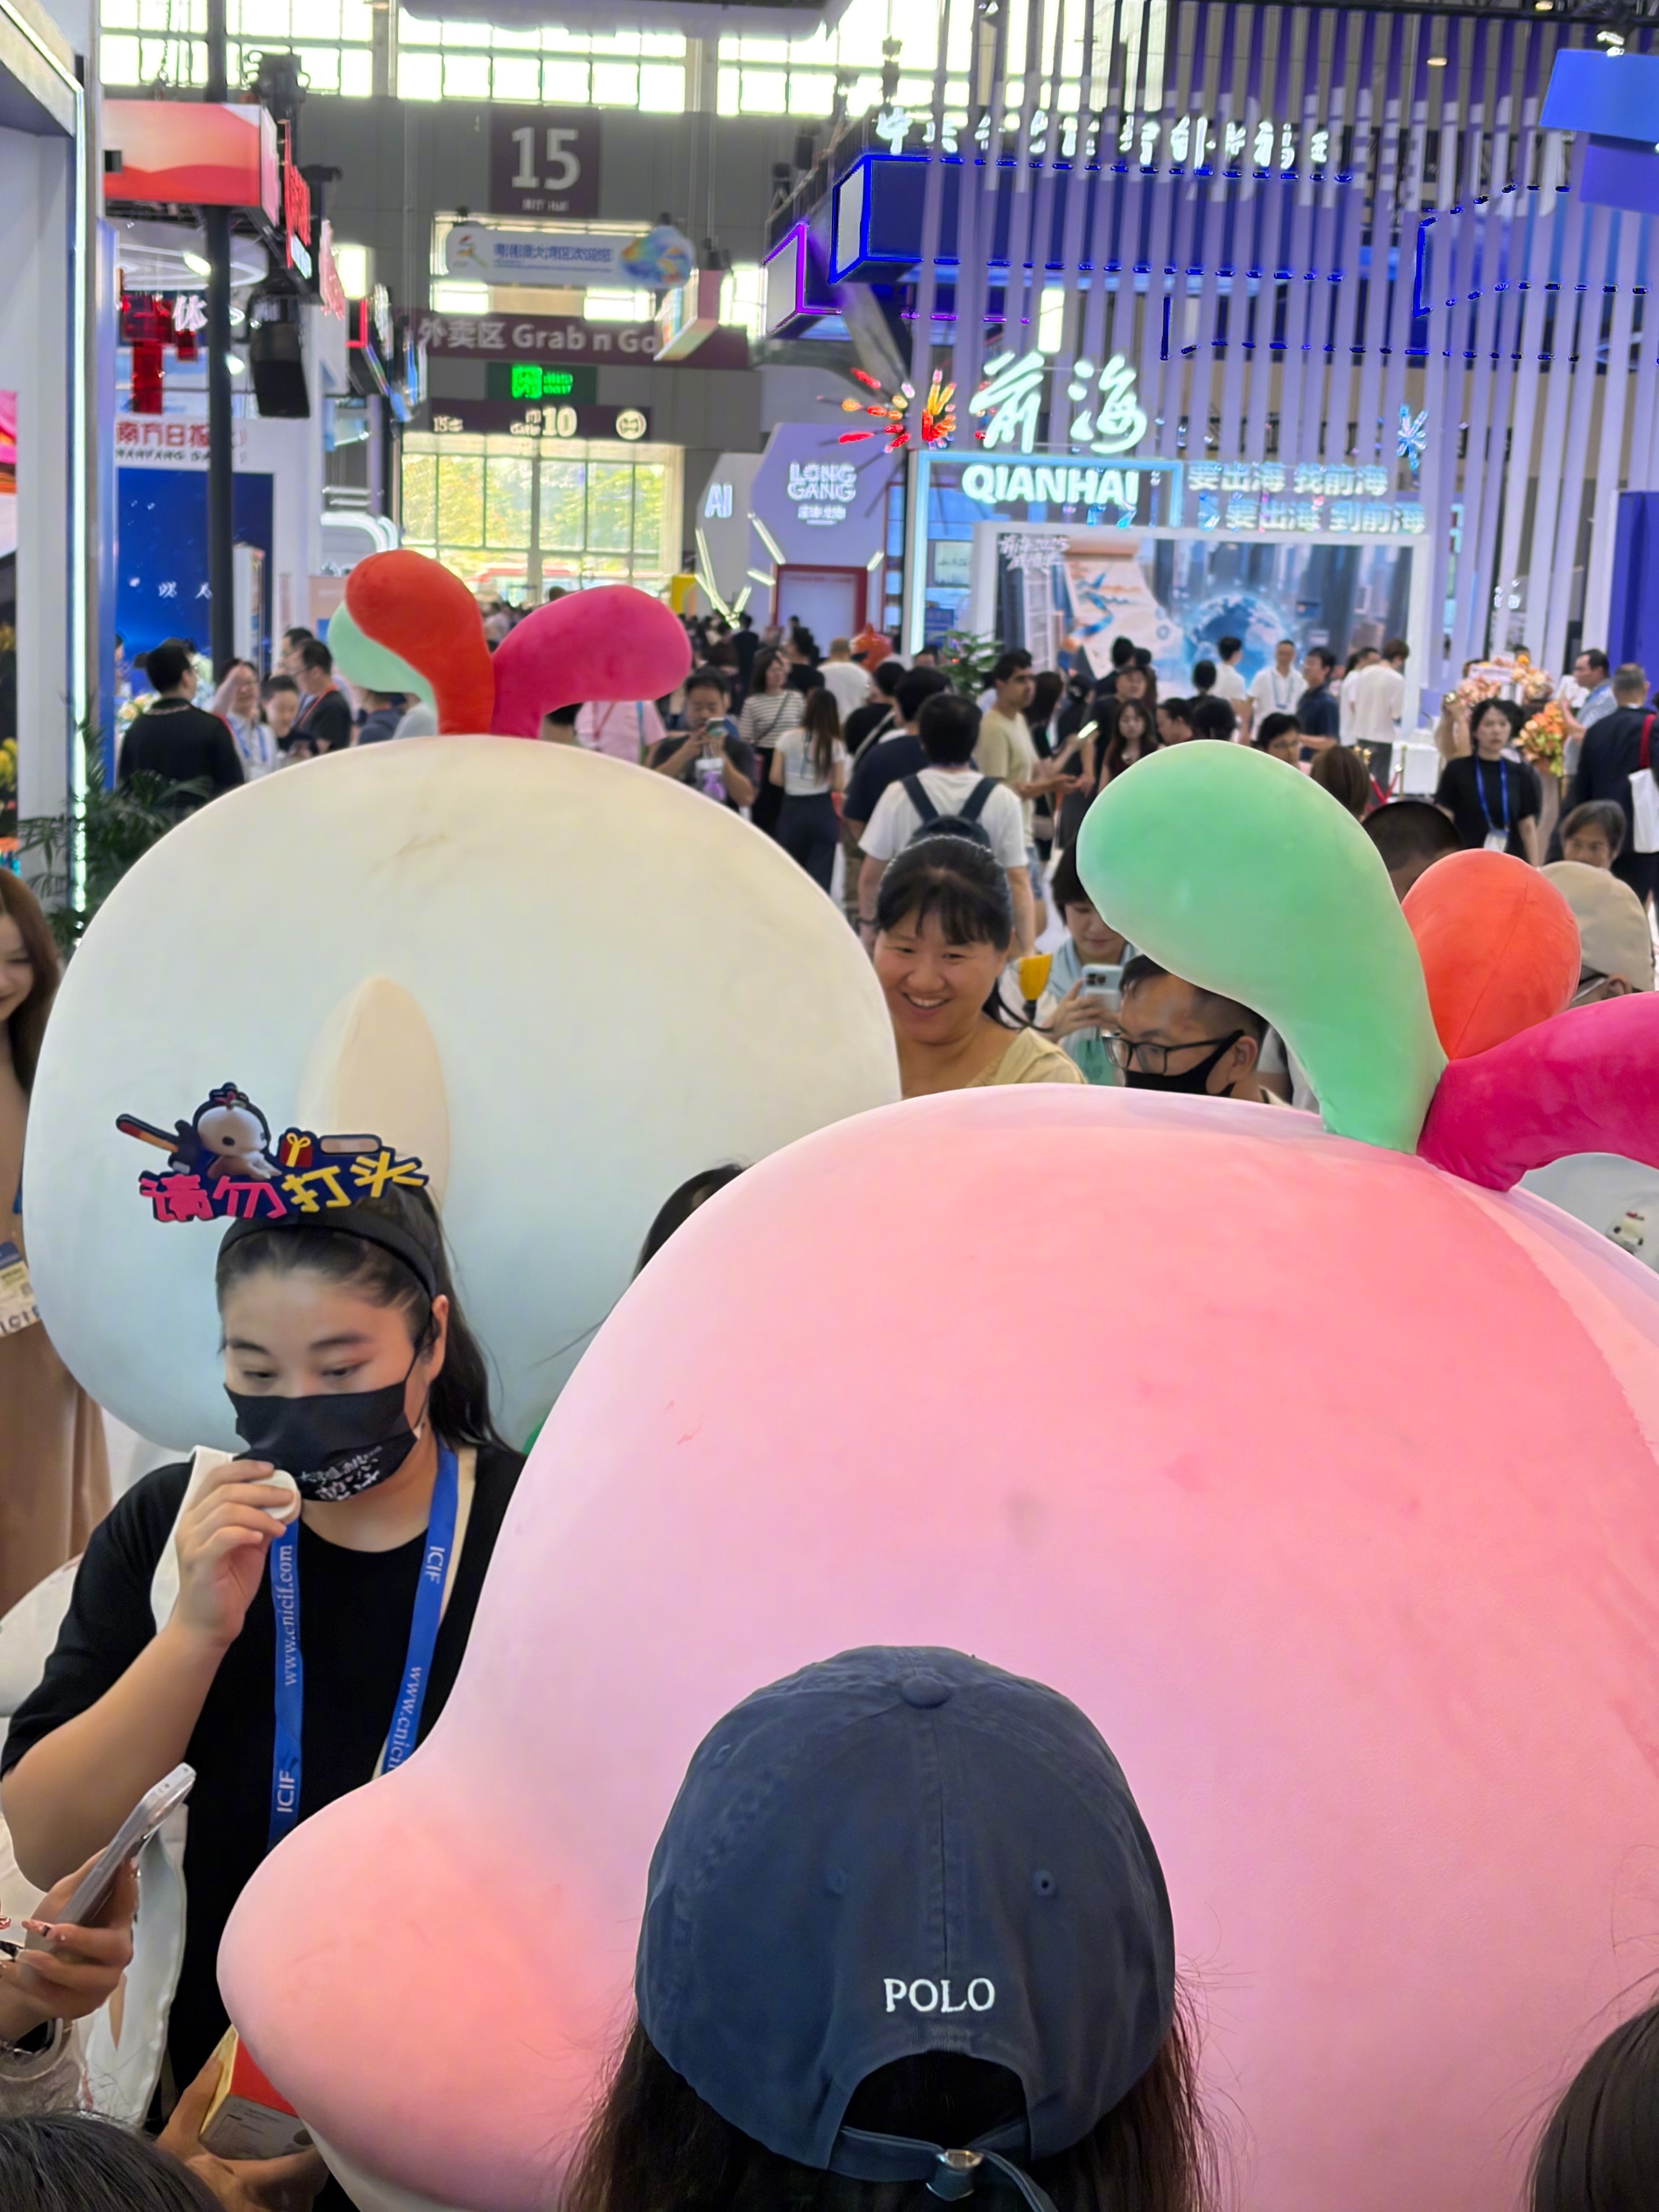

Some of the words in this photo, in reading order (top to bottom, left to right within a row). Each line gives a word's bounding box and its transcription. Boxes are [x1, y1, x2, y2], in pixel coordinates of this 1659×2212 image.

[511, 125, 582, 191] 15
[419, 317, 505, 350] 外卖区
[512, 324, 584, 351] Grab
[593, 331, 612, 351] n
[618, 329, 658, 354] Go
[542, 405, 578, 437] 10
[969, 352, 1147, 454] 前海
[788, 482, 856, 502] GANG
[789, 463, 857, 483] LONG
[962, 465, 1139, 504] QIANHAI
[705, 484, 733, 518] AI
[140, 1151, 426, 1221] 请勿打头
[426, 1546, 445, 1584] ICIF
[276, 1544, 298, 1687] www.cnicif.com
[277, 1771, 294, 1814] ICIF
[883, 1978, 996, 2013] POLO
